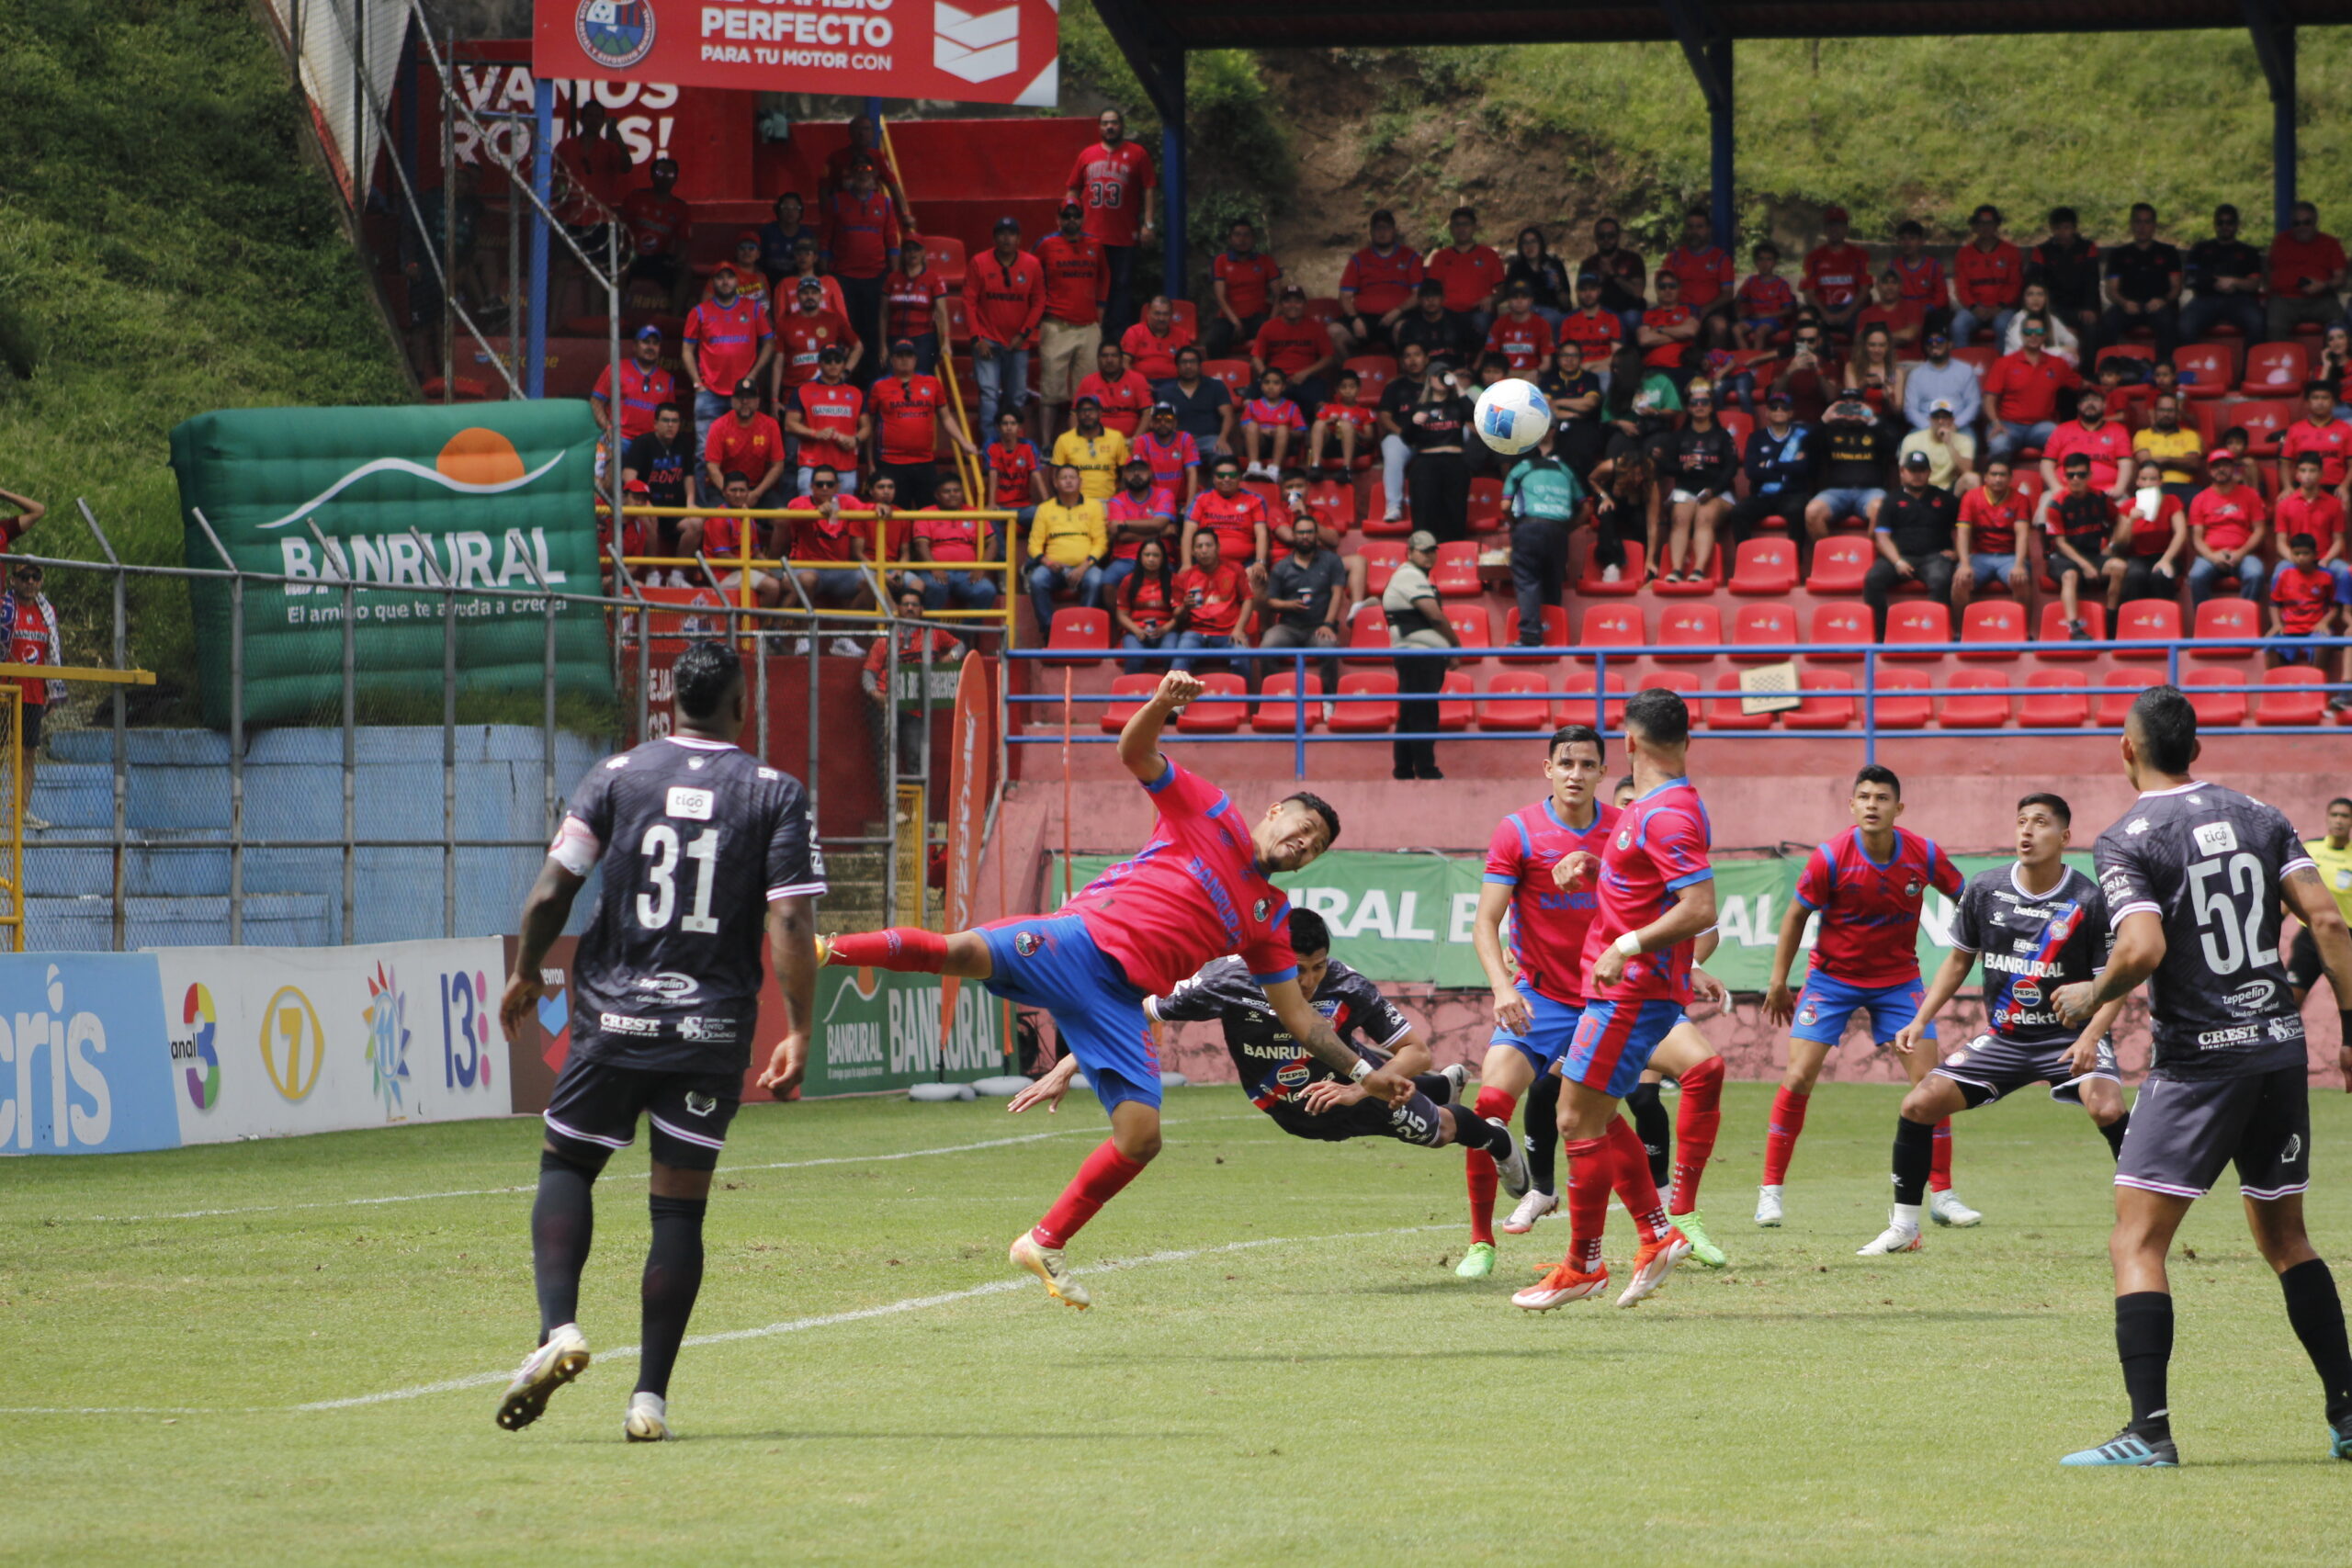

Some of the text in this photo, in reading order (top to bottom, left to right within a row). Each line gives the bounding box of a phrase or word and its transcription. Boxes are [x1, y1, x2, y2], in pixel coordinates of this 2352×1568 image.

[701, 6, 893, 48] PERFECTO
[701, 44, 893, 72] PARA TU MOTOR CON
[1090, 181, 1122, 209] 33
[280, 526, 566, 596] BANRURAL
[288, 605, 305, 624] El
[310, 603, 369, 622] amio
[374, 604, 410, 624] que
[413, 601, 431, 618] te
[495, 600, 506, 615] a
[675, 793, 704, 812] tigo
[2204, 826, 2227, 846] tigo
[636, 824, 719, 935] 31
[1539, 891, 1599, 910] BANRU
[2012, 904, 2051, 919] betcris
[2188, 852, 2279, 976] 52
[1984, 953, 2065, 978] BANRURAL
[639, 977, 685, 990] Zeppelin
[2013, 988, 2041, 998] PEPSI
[2222, 987, 2266, 1006] Zeppelin
[441, 970, 478, 1089] 13
[600, 1012, 662, 1032] CREST
[888, 986, 1002, 1074] BANRURAL
[2197, 1024, 2259, 1045] CREST
[169, 982, 221, 1110] anal 3
[278, 1007, 304, 1095] 7
[375, 1010, 397, 1069] 11
[827, 1021, 883, 1065] BANRURAL
[1279, 1070, 1307, 1079] PEPSI
